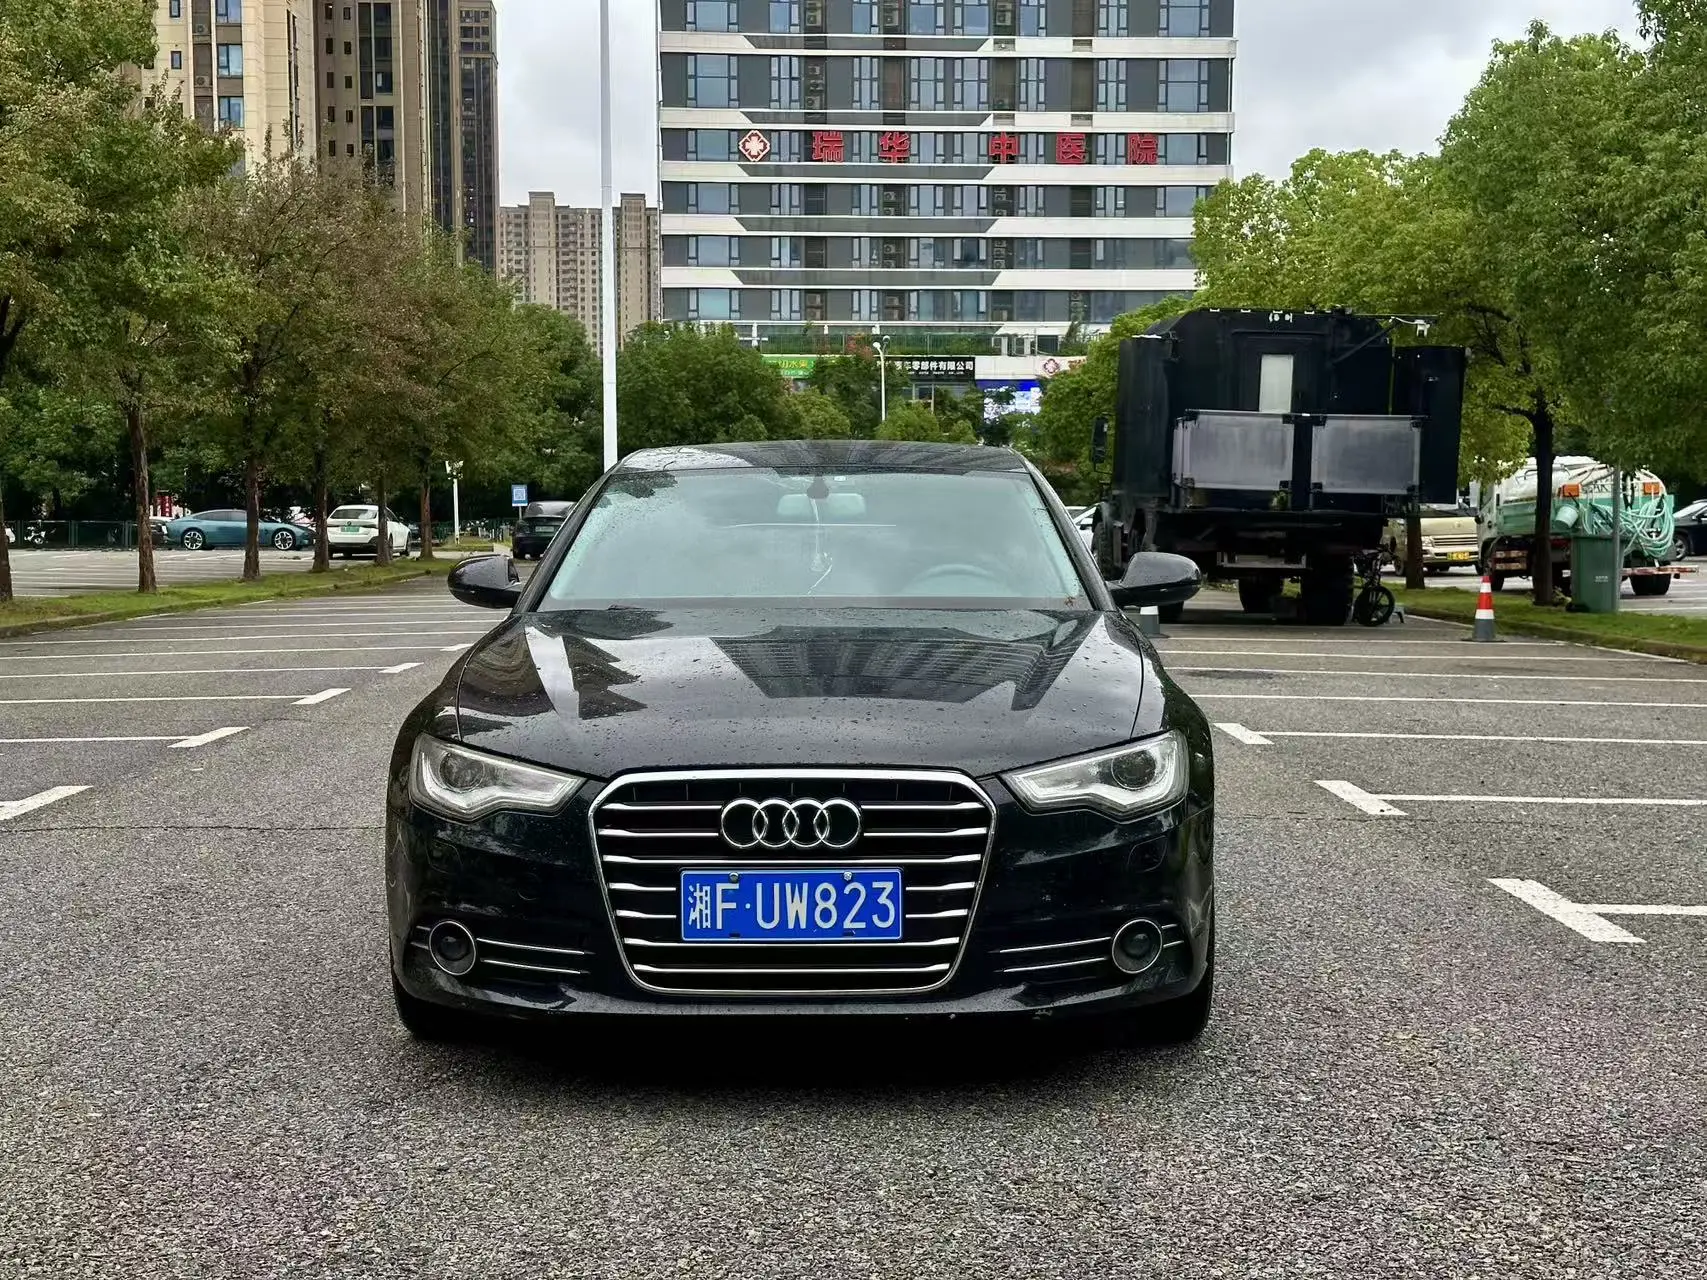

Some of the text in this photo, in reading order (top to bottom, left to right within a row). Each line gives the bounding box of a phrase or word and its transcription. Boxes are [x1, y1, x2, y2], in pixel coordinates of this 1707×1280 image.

[812, 130, 1158, 164] 瑞华中医院
[688, 881, 896, 930] 湘F·UW823
